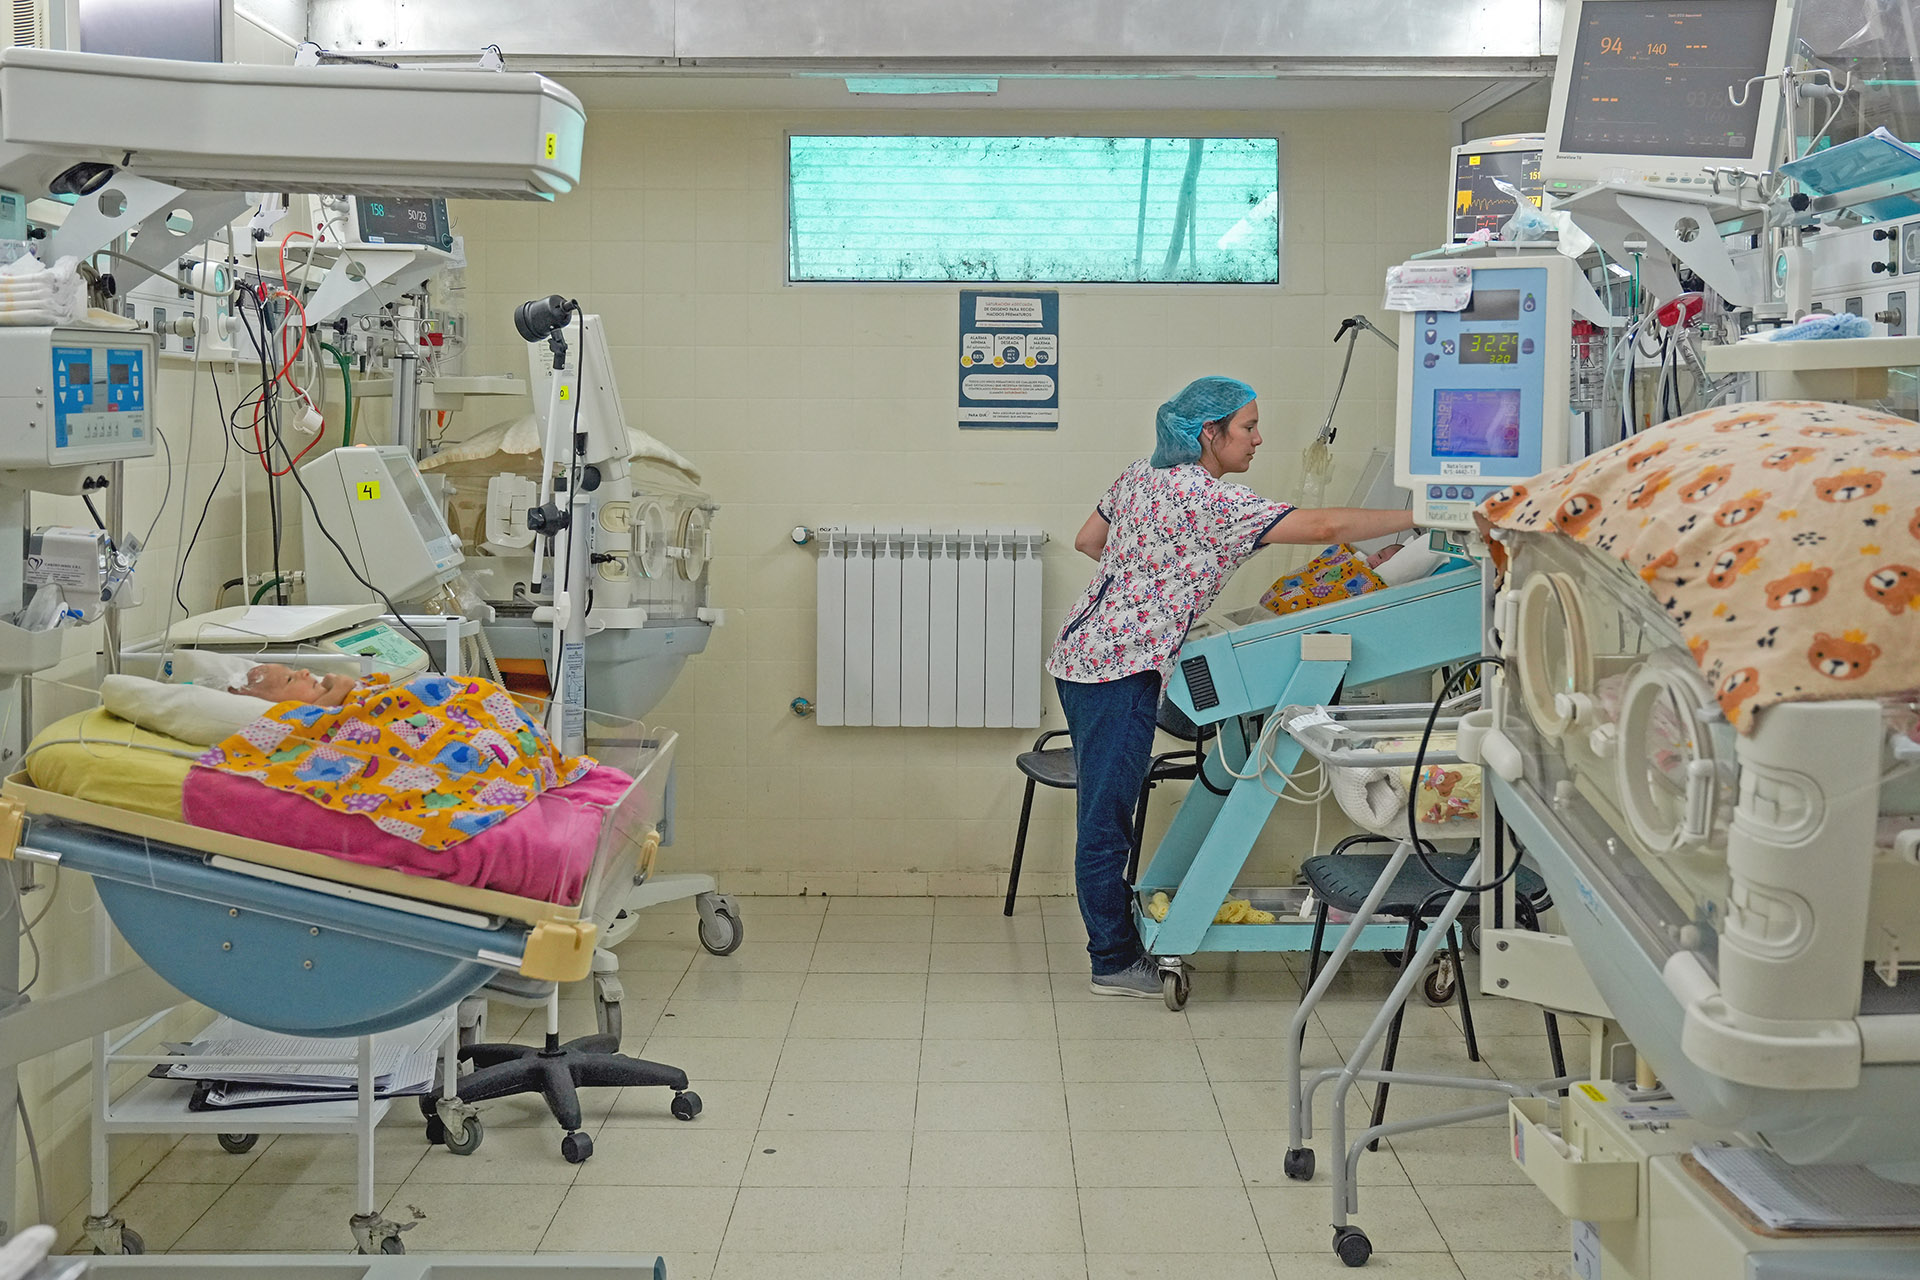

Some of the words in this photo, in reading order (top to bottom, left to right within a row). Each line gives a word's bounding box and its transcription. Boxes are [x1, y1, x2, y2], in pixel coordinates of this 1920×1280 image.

[1600, 37, 1623, 55] 94
[1647, 43, 1667, 55] 140
[548, 137, 554, 156] 5
[371, 203, 385, 217] 158
[408, 209, 427, 222] 50/23
[363, 484, 373, 499] 4
[1429, 512, 1457, 521] NatalCare
